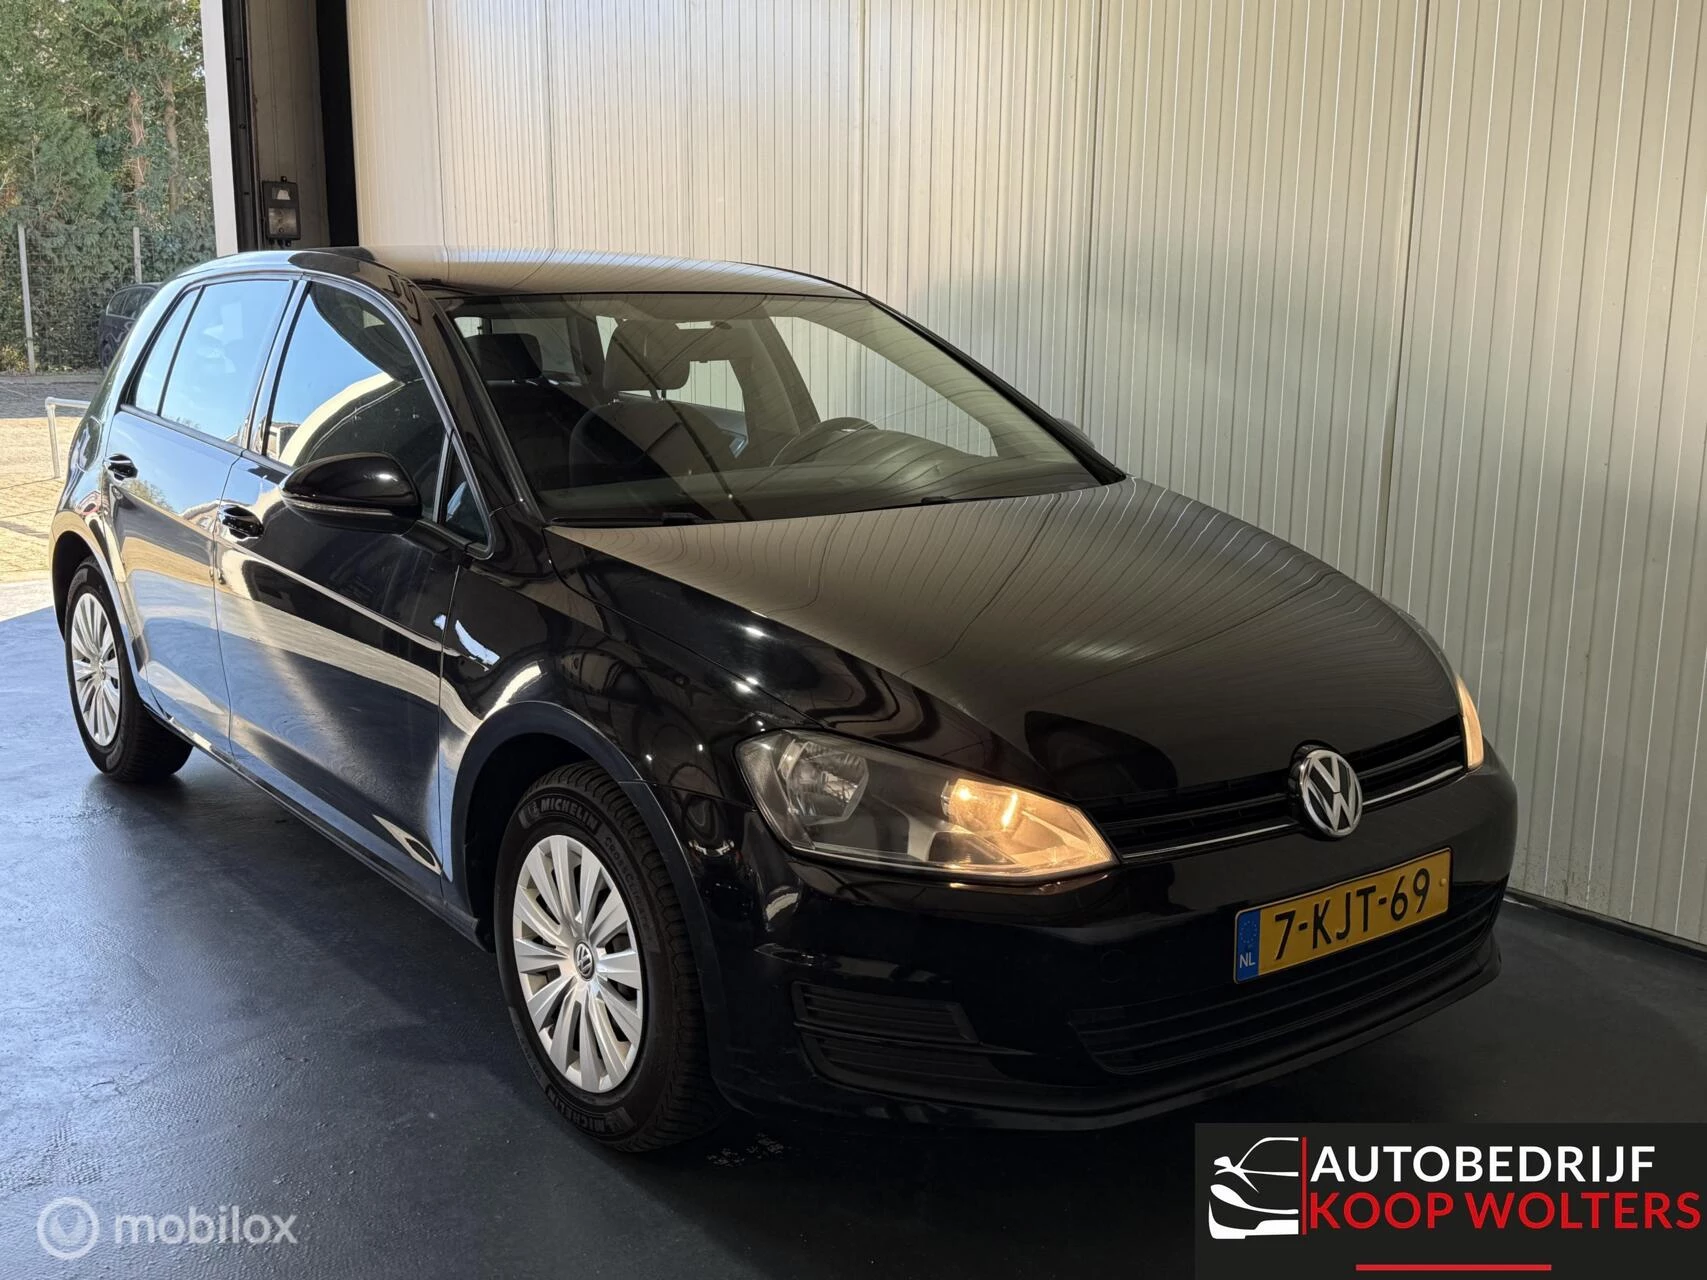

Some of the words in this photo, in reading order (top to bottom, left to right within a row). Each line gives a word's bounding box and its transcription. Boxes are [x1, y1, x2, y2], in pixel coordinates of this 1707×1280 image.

[540, 797, 601, 833] MICHELIN
[1274, 867, 1430, 961] 7-KJT-69
[1239, 952, 1256, 969] NL
